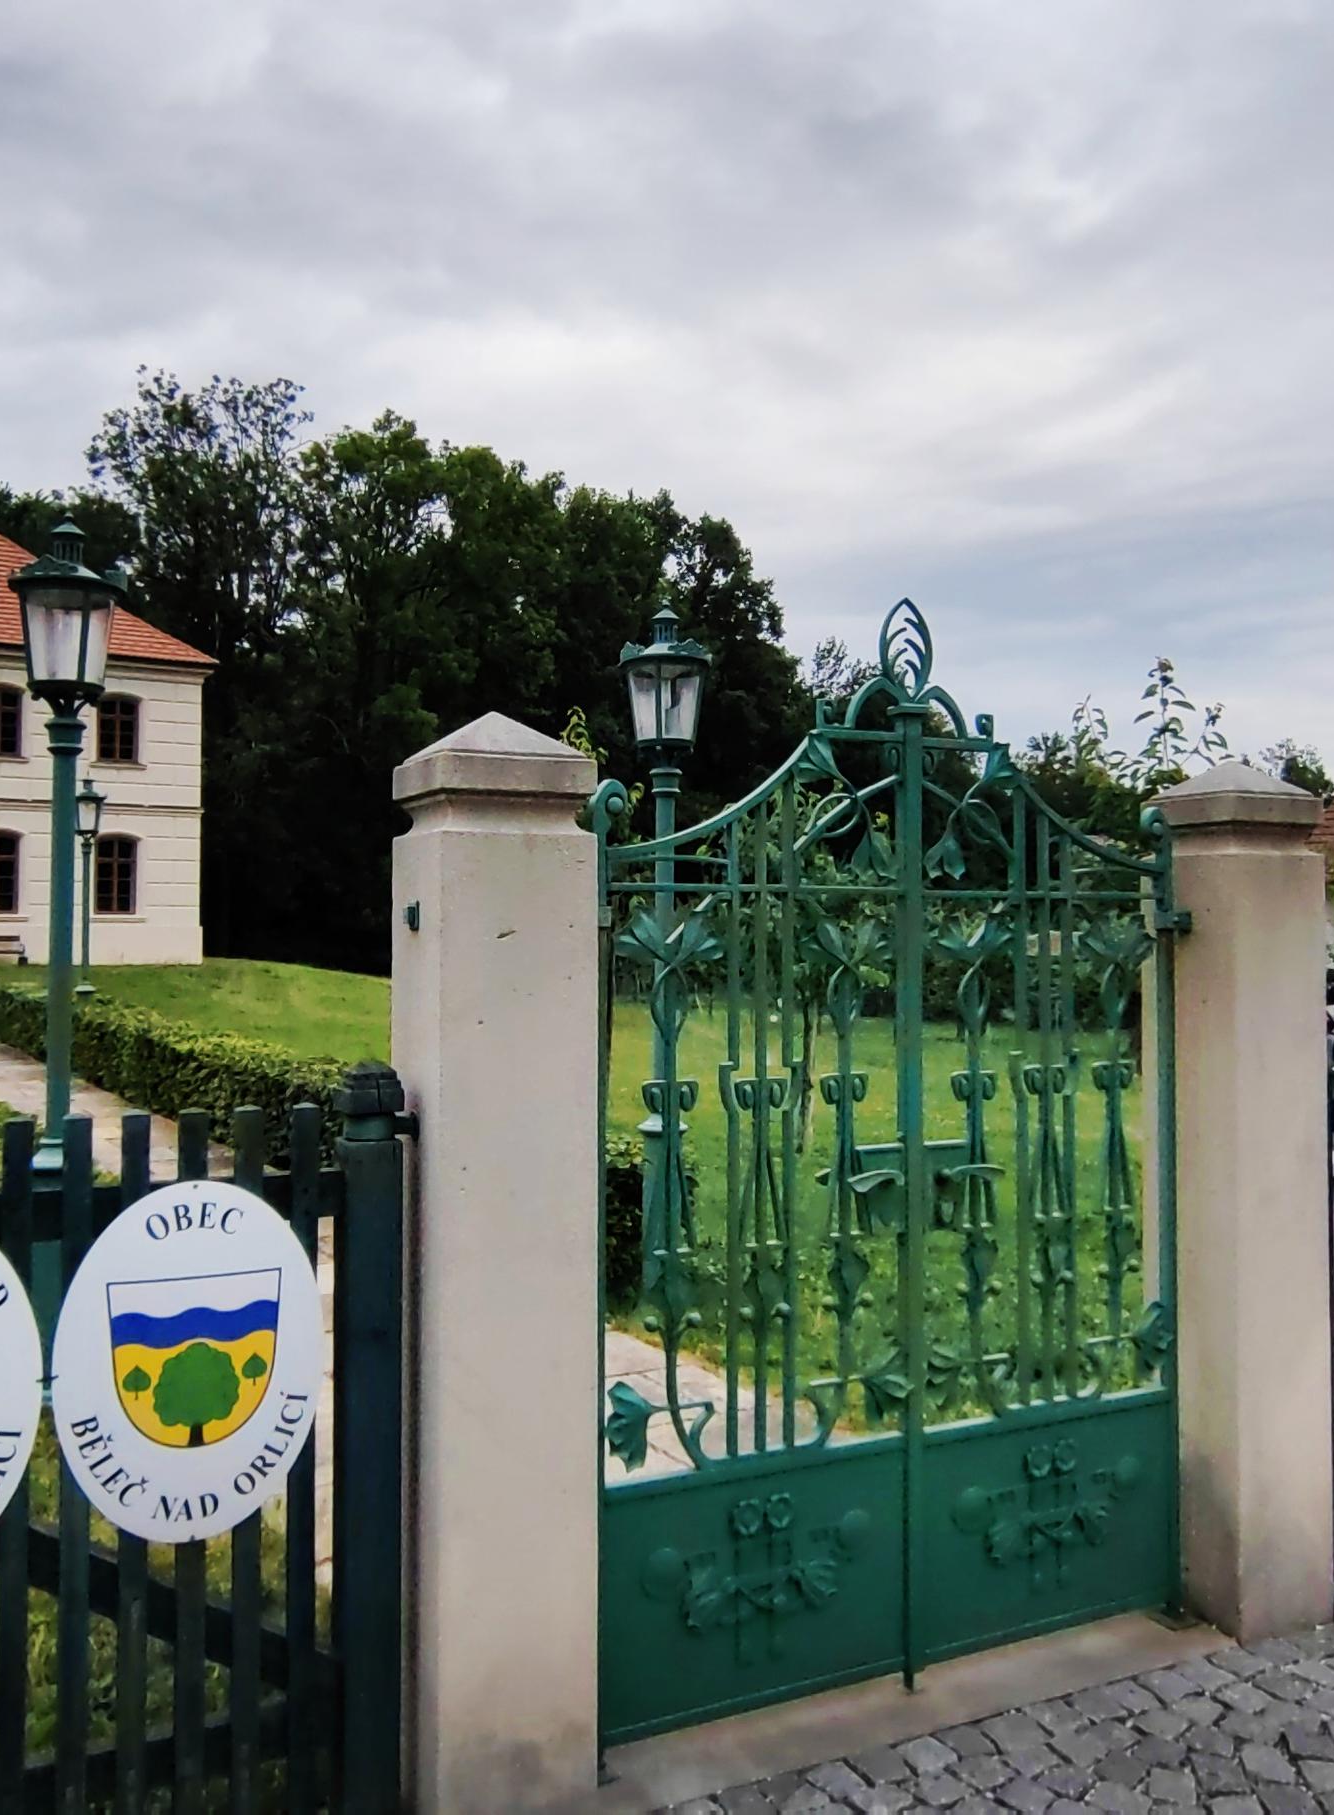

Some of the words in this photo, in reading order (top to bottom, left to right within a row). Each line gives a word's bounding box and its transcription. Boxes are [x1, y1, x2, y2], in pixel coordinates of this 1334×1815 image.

[145, 1201, 244, 1240] OBEC
[70, 1415, 149, 1508] BĚLEČ
[151, 1492, 219, 1523] NAD
[233, 1391, 309, 1495] ORLICÍ
